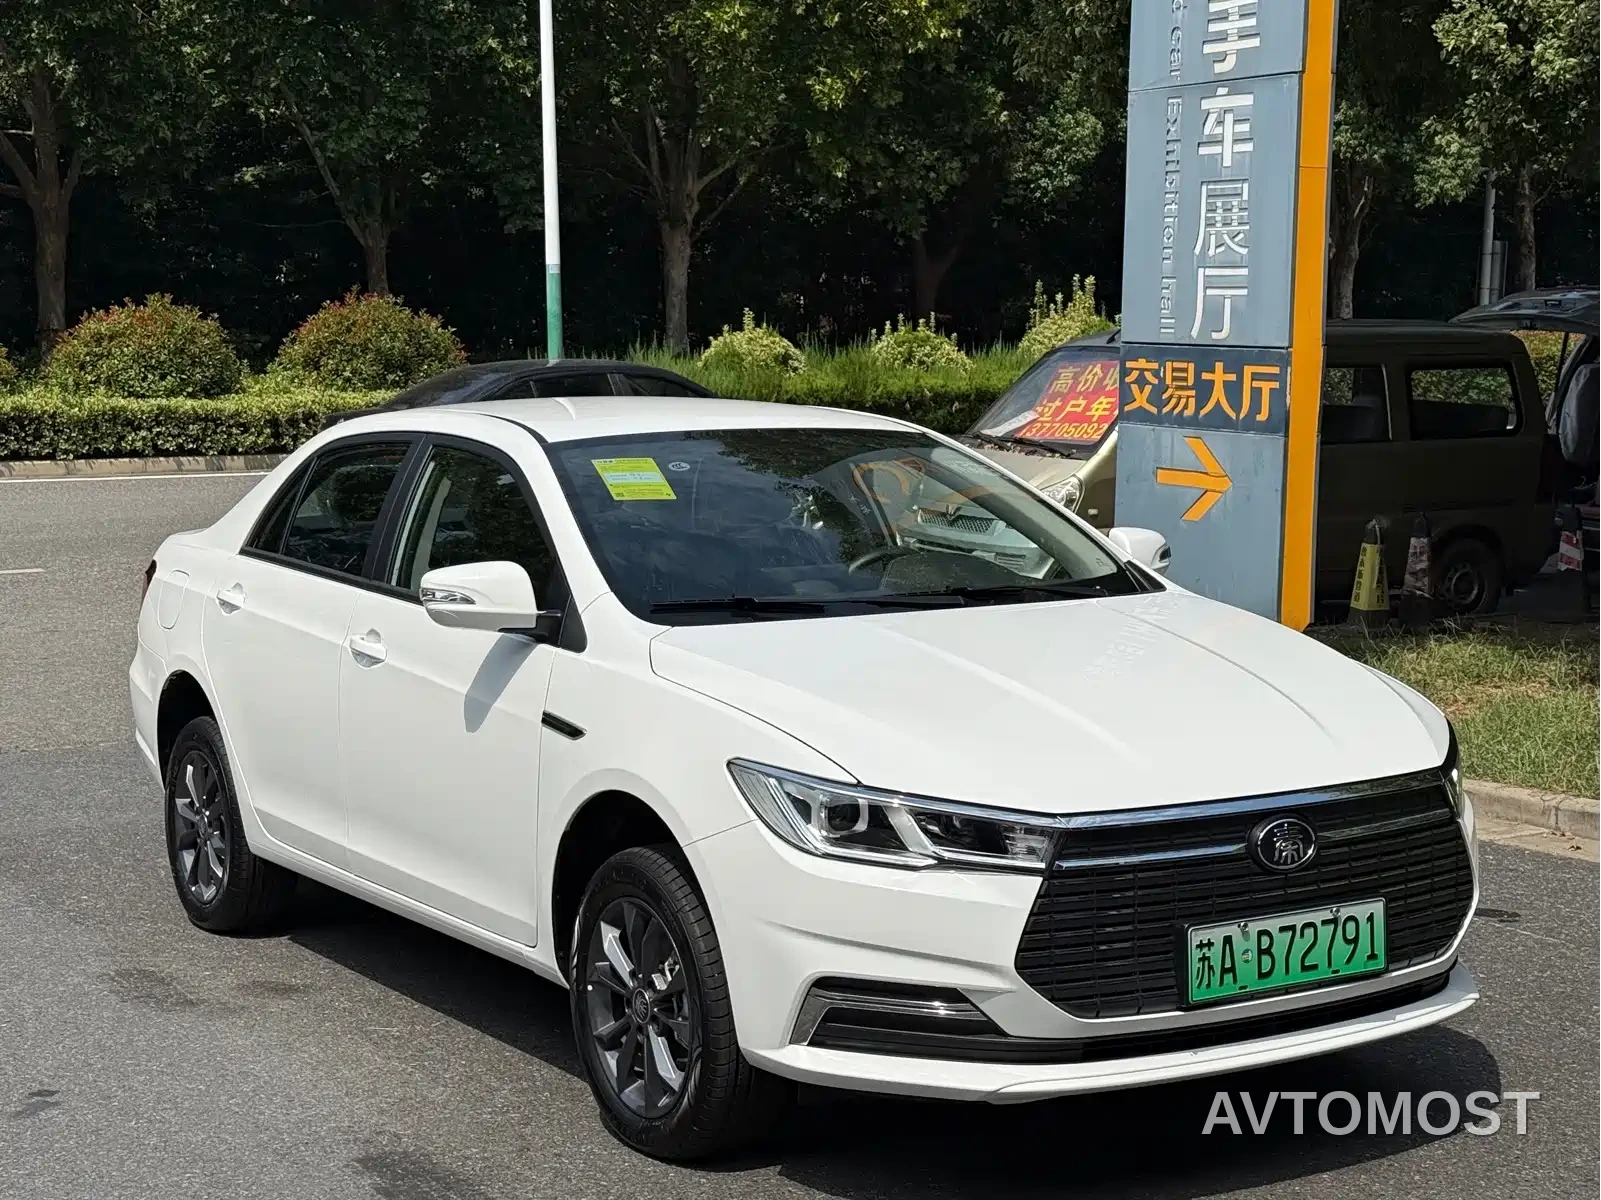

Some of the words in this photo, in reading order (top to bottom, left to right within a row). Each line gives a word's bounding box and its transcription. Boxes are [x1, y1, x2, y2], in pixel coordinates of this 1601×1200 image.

[1159, 276, 1177, 334] hall
[1035, 395, 1119, 422] 过户年
[1123, 357, 1281, 422] 交易大厅
